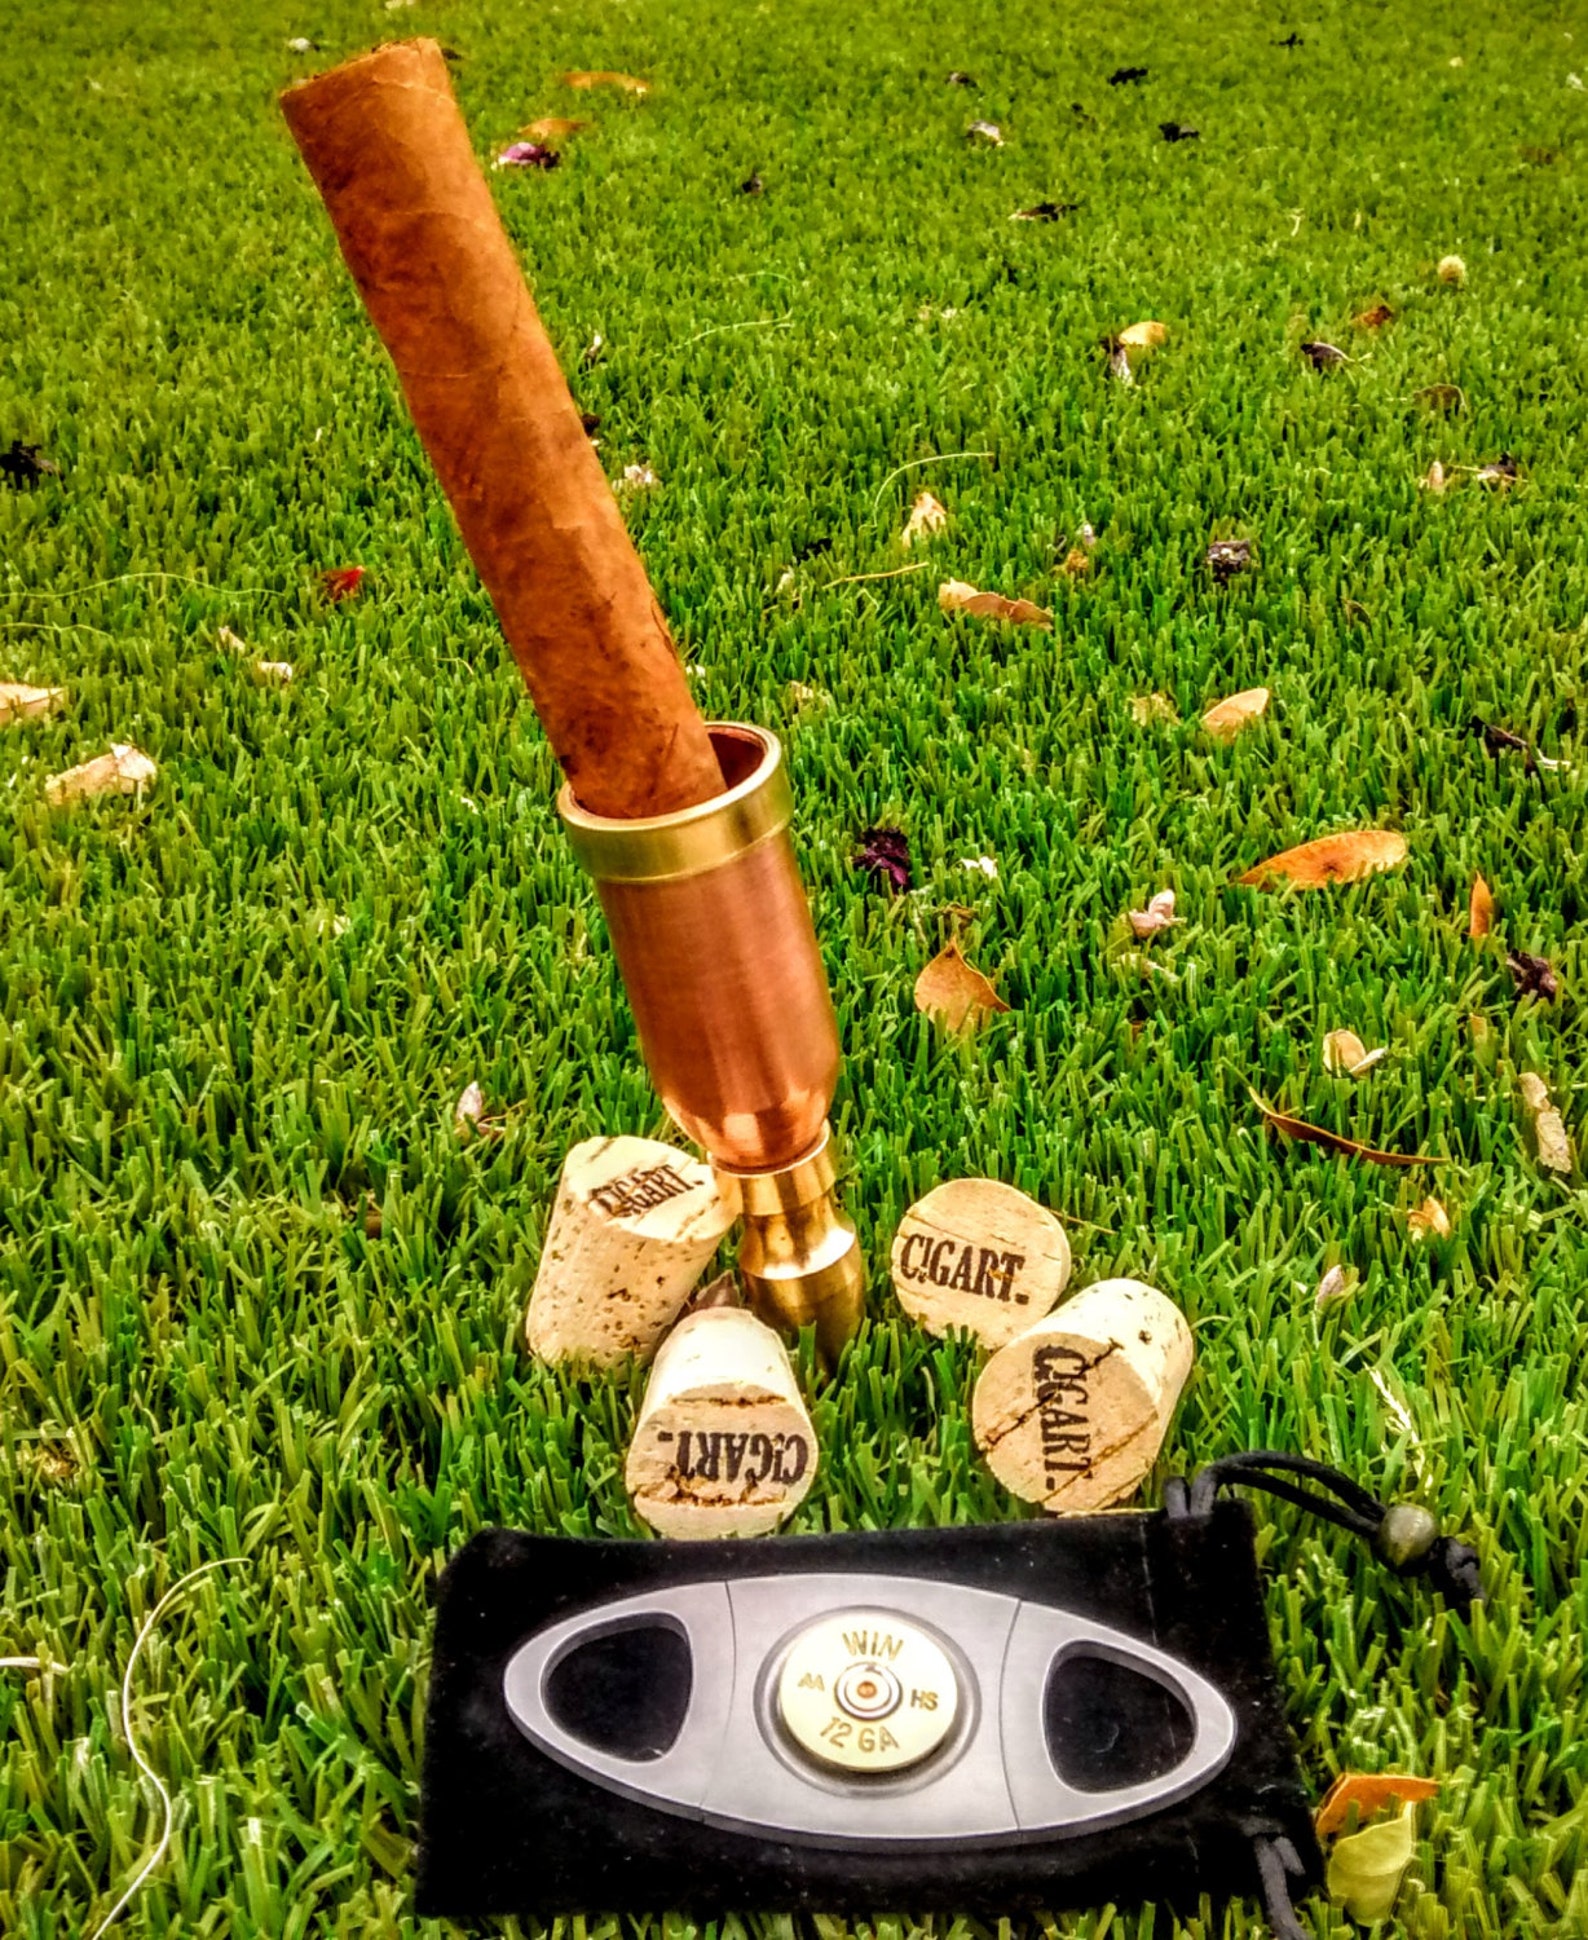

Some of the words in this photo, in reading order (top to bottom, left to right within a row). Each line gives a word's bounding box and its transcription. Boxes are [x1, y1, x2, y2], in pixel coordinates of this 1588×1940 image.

[842, 1630, 904, 1661] WIN
[798, 1672, 825, 1691] AA
[911, 1689, 938, 1711] HS
[820, 1716, 853, 1748] 12
[858, 1726, 900, 1753] GA
